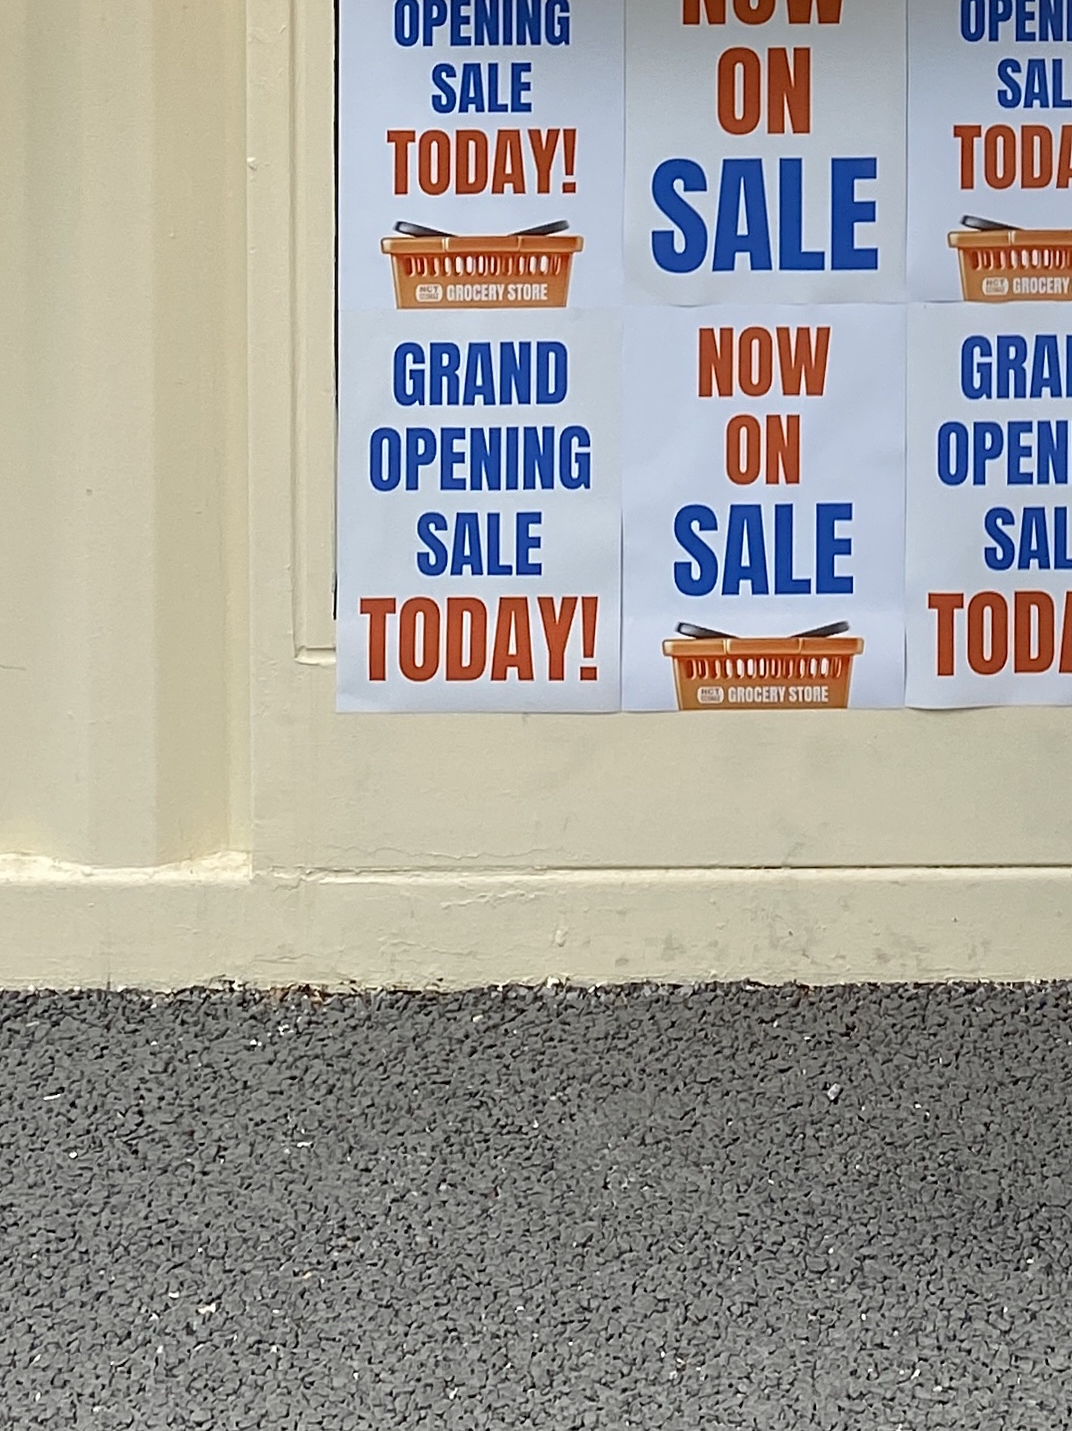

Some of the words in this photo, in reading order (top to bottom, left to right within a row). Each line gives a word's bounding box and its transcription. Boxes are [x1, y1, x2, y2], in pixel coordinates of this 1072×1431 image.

[431, 62, 533, 114] SALE
[717, 46, 812, 135] ON
[387, 127, 577, 196] TODAY!
[651, 156, 878, 274] SALE
[446, 283, 505, 302] GROCERY
[507, 283, 548, 301] STORE
[1012, 276, 1070, 294] GROCERY
[393, 341, 568, 406] GRAND
[698, 326, 831, 398] NOW
[369, 425, 591, 492] OPENING
[725, 413, 801, 486] ON
[416, 511, 543, 577] SALE
[673, 502, 854, 597] SALE
[360, 596, 599, 682] TODAY!
[728, 686, 786, 703] GROCERY
[788, 685, 829, 703] STORE
